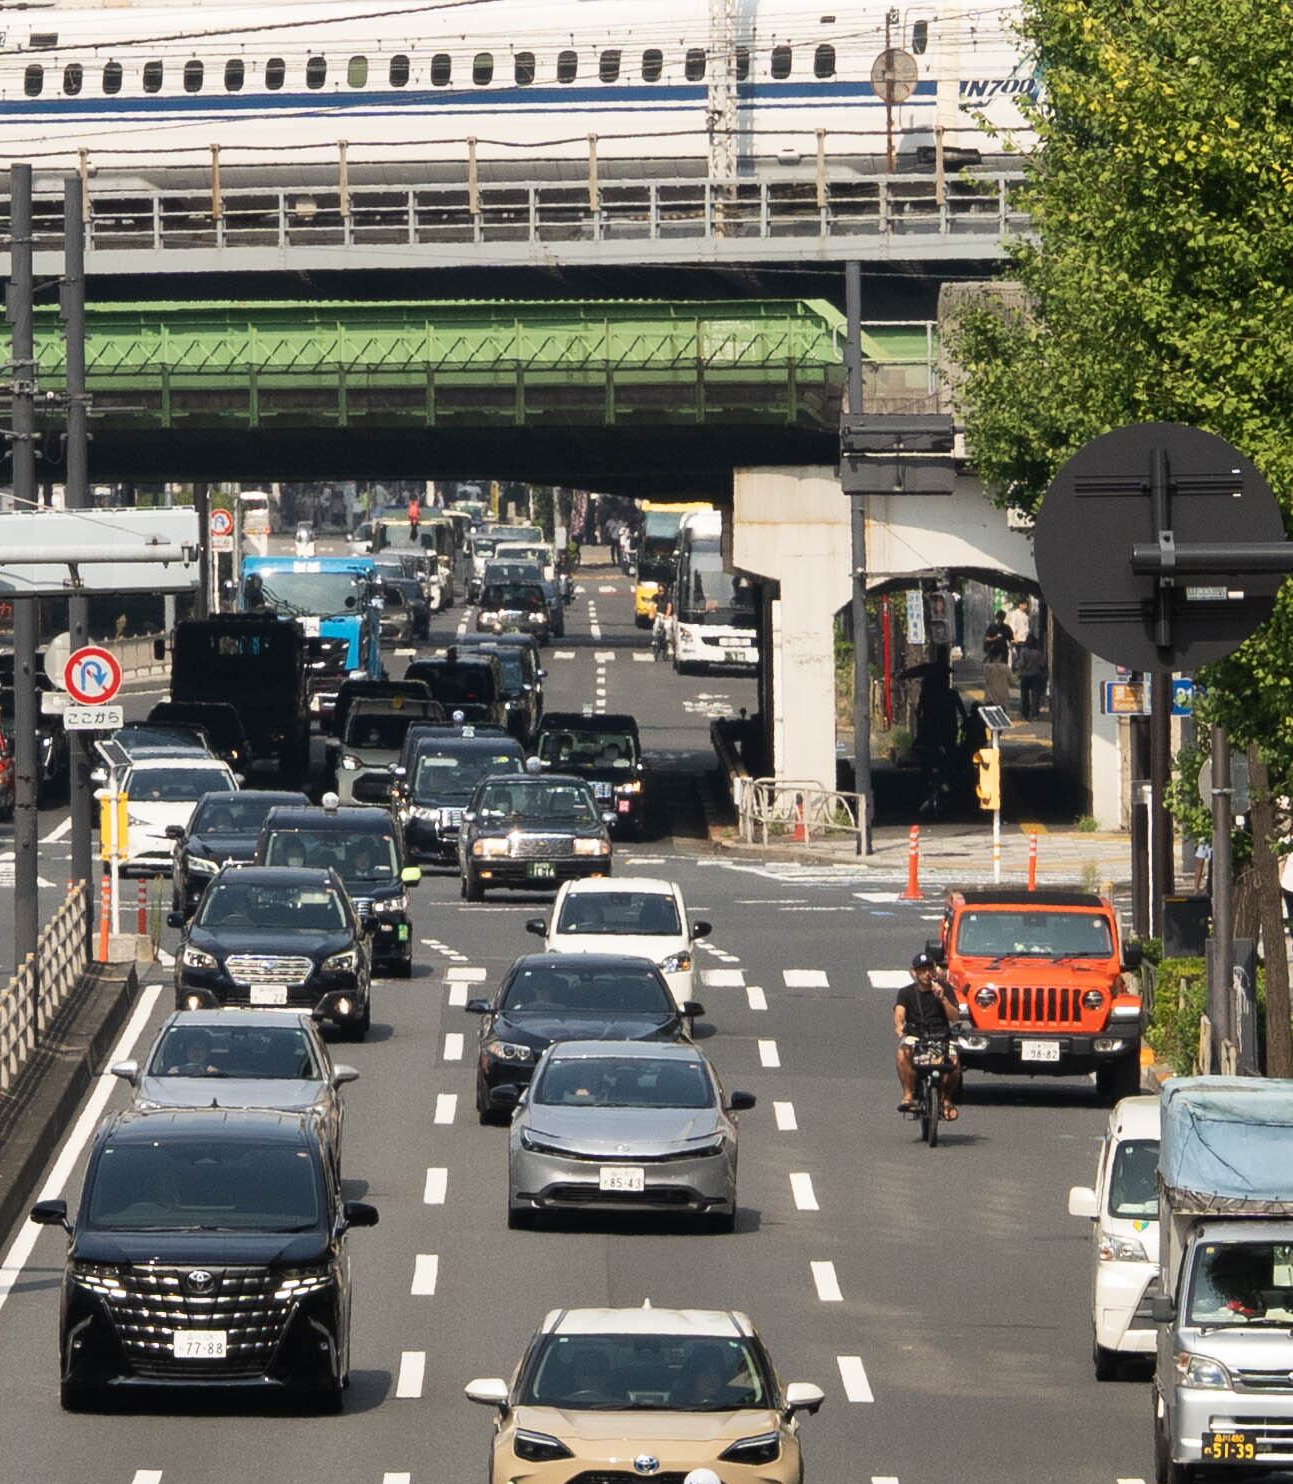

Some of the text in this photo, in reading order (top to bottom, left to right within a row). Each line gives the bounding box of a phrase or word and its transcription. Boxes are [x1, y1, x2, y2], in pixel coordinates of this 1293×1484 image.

[67, 711, 121, 725] ここから
[186, 1342, 224, 1355] 77-88
[1213, 1442, 1254, 1458] 51-39
